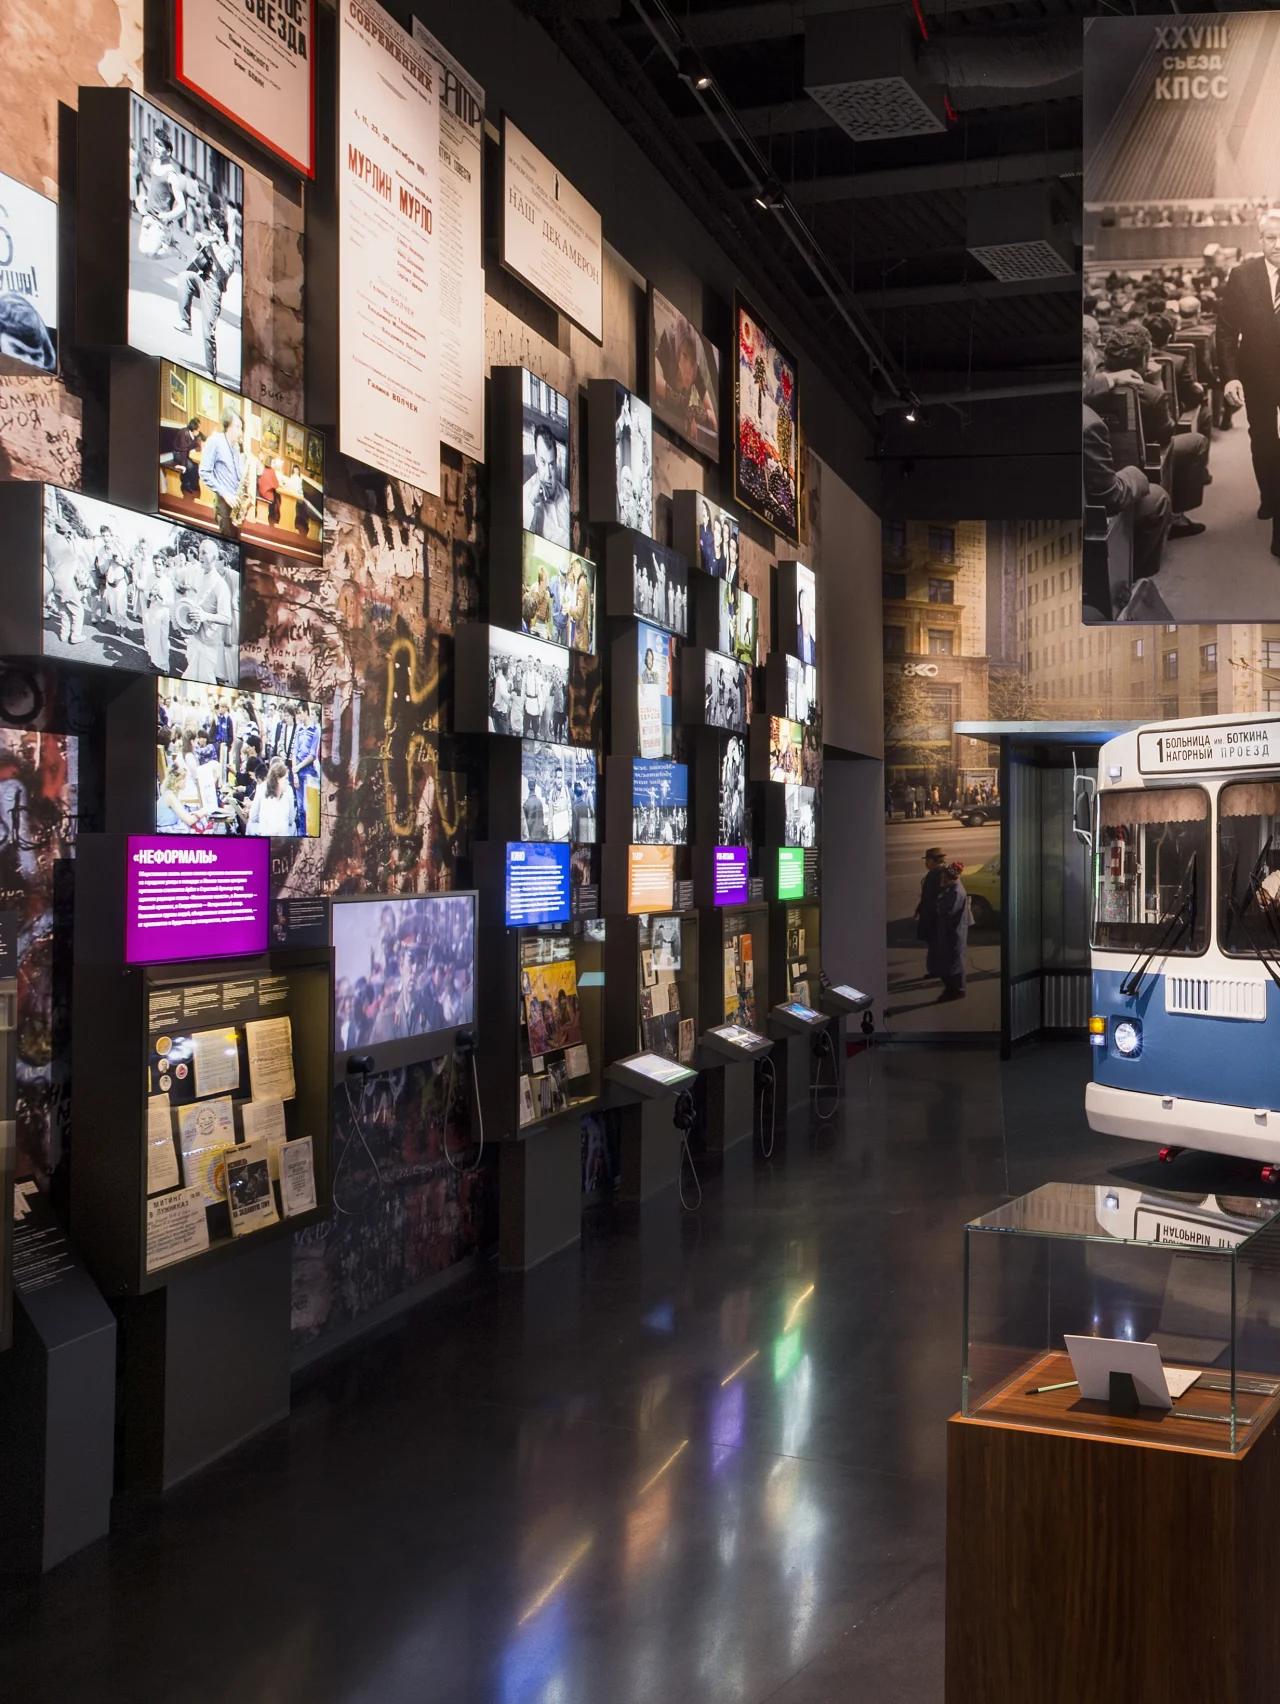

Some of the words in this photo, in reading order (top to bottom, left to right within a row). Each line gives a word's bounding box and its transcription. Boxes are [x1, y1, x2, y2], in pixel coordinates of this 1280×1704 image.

[349, 1, 433, 95] СОВРЕМЕННИК
[1155, 26, 1229, 49] XXVIII
[1162, 54, 1223, 71] СЪЕЗД
[1154, 76, 1229, 100] КПСС
[347, 143, 392, 203] МУРЛИН
[399, 185, 433, 236] МУРЛО
[508, 187, 536, 225] НАШ
[541, 219, 601, 286] ДЕКАМЕРОН
[367, 378, 390, 397] Галина
[391, 392, 419, 413] ВОЛЧЕК
[1156, 737, 1164, 763] 1
[1165, 735, 1211, 749] БОЛЬНИЦА
[1213, 738, 1225, 746] им.
[1226, 730, 1268, 744] БОТКИНА
[1166, 746, 1213, 762] НАГОРНЫЙ
[1220, 744, 1270, 759] ПРОЕЗД
[133, 849, 218, 864] «НЕФОРМАЛЫ»
[153, 1193, 182, 1209] МИТИНГ
